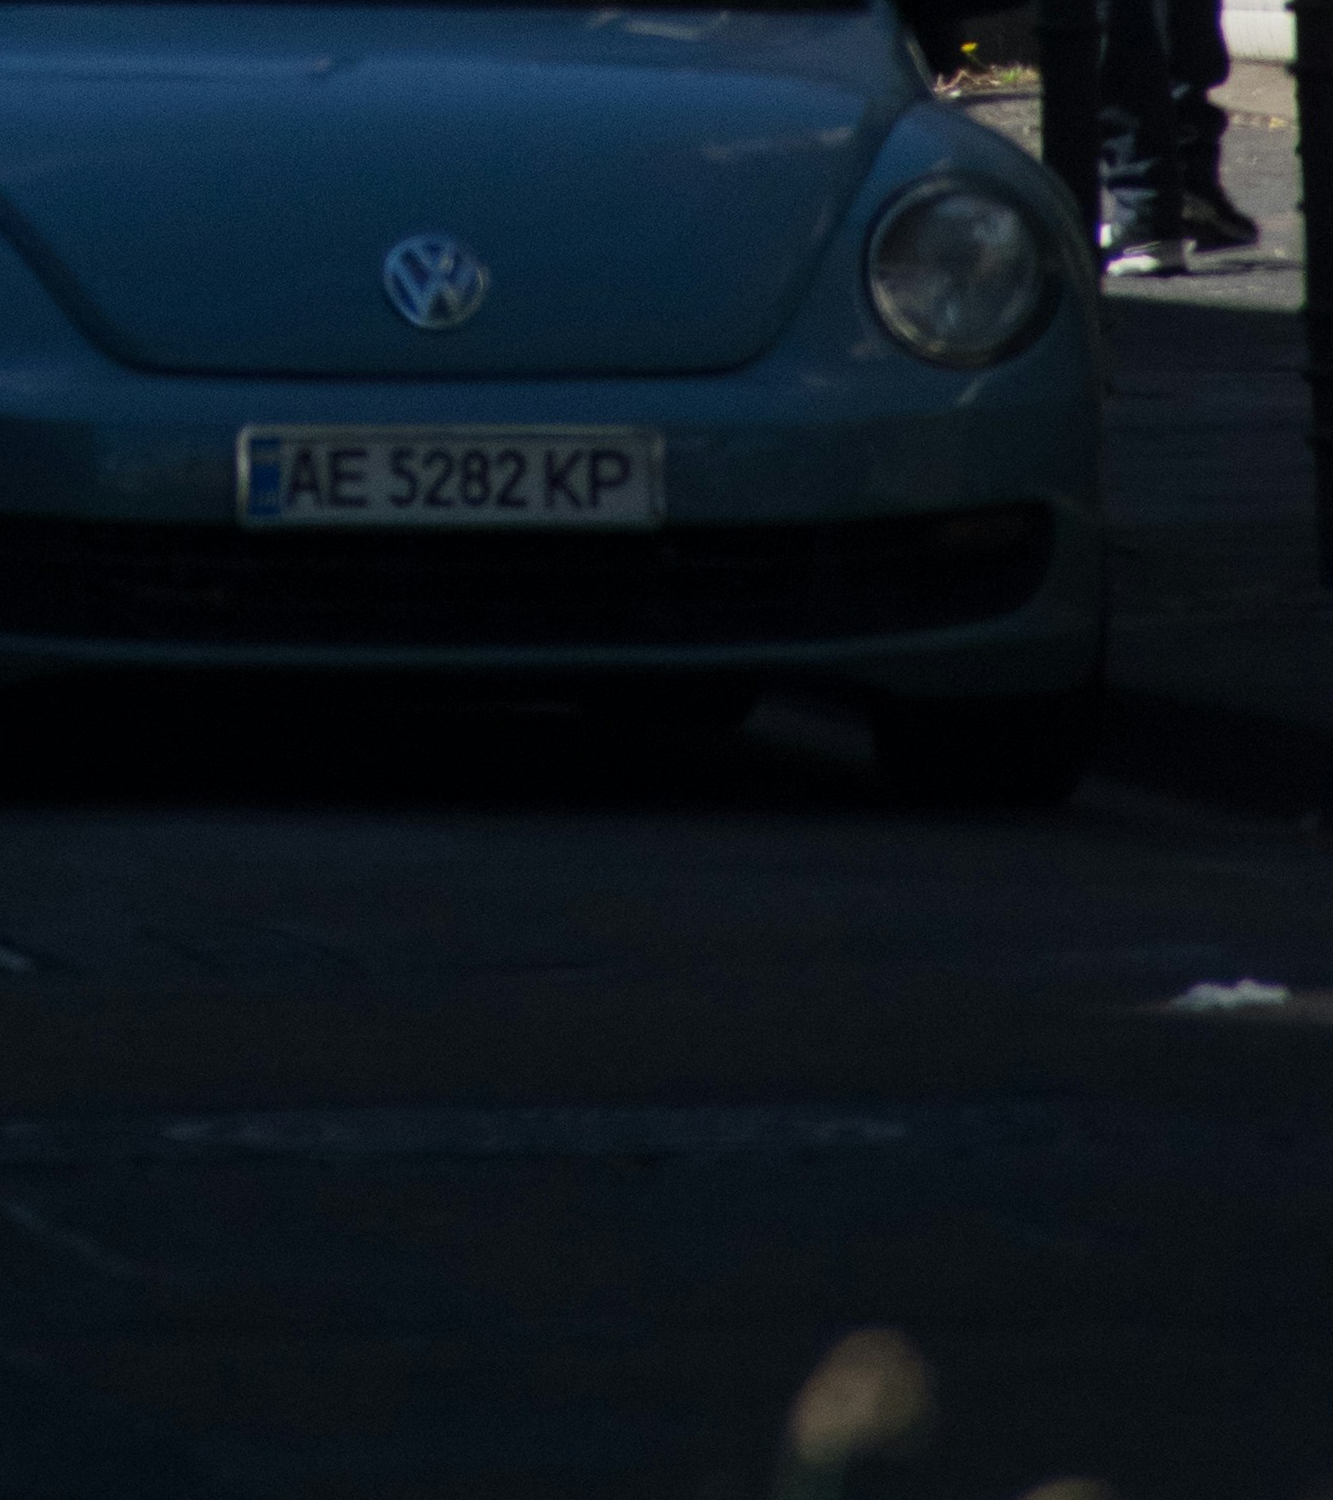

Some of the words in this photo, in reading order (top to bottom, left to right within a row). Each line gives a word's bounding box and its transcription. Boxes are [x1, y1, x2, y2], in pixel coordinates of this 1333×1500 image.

[287, 447, 367, 509] AE
[389, 448, 529, 509] 5282
[543, 448, 632, 509] KP
